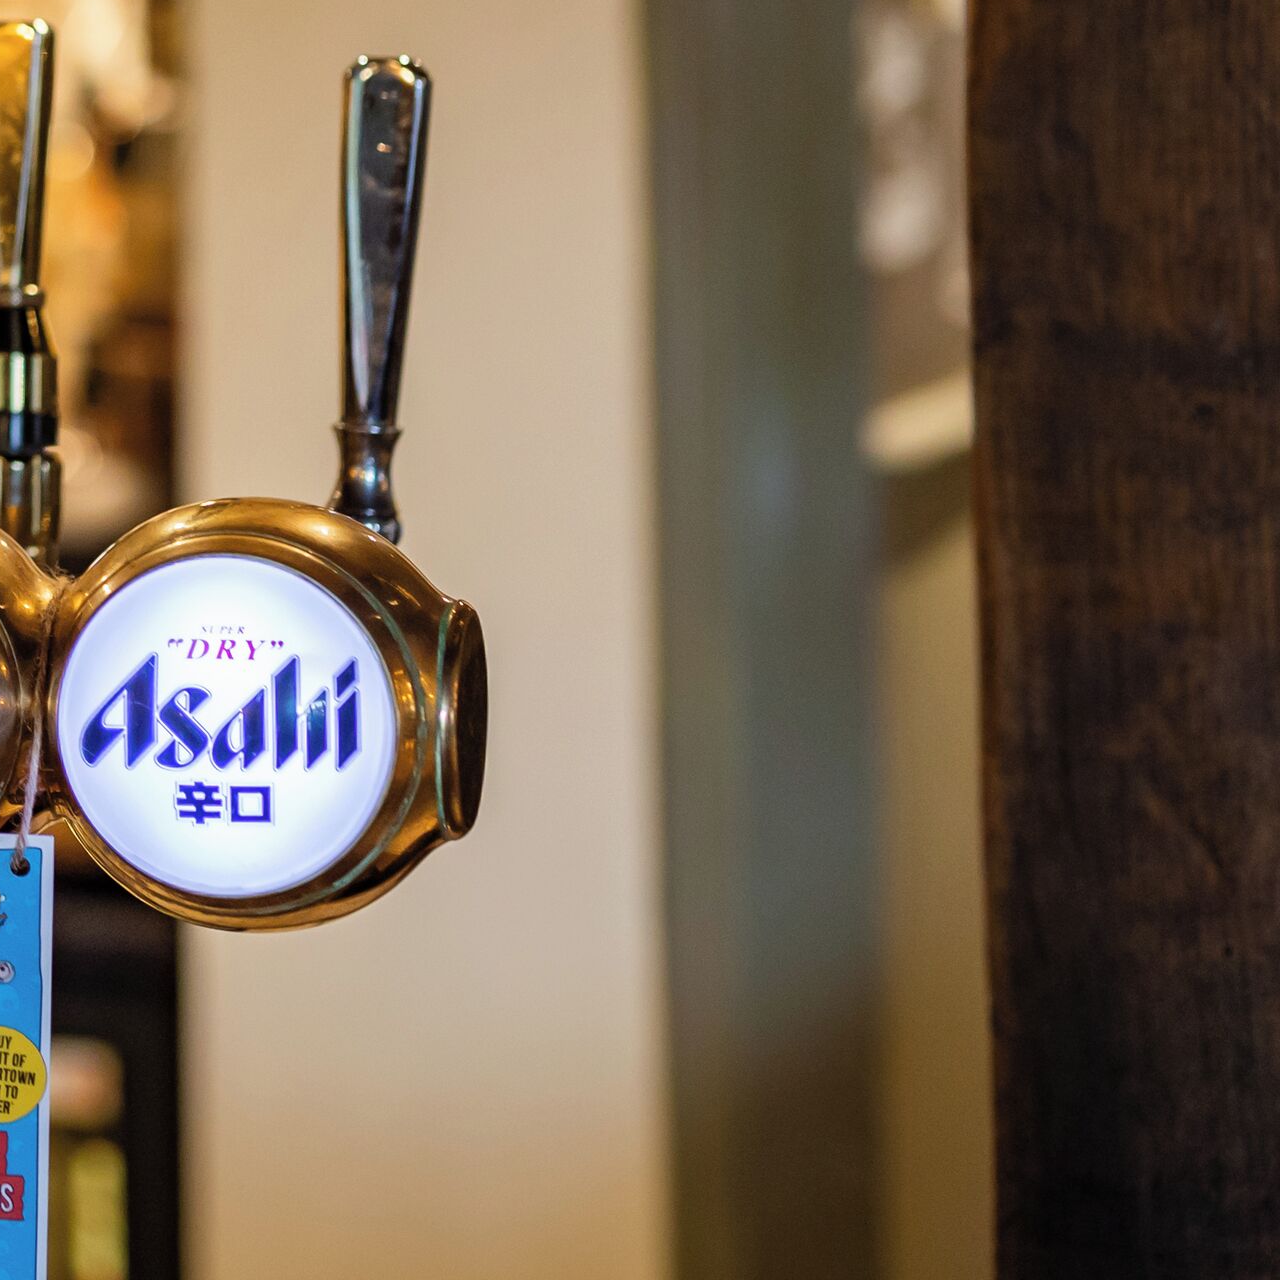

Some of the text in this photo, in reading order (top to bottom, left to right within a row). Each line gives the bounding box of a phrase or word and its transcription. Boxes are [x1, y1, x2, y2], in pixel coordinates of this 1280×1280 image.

[81, 652, 359, 772] Asahi
[175, 780, 272, 825] 辛口
[12, 1053, 26, 1067] OF
[5, 1085, 18, 1099] TO
